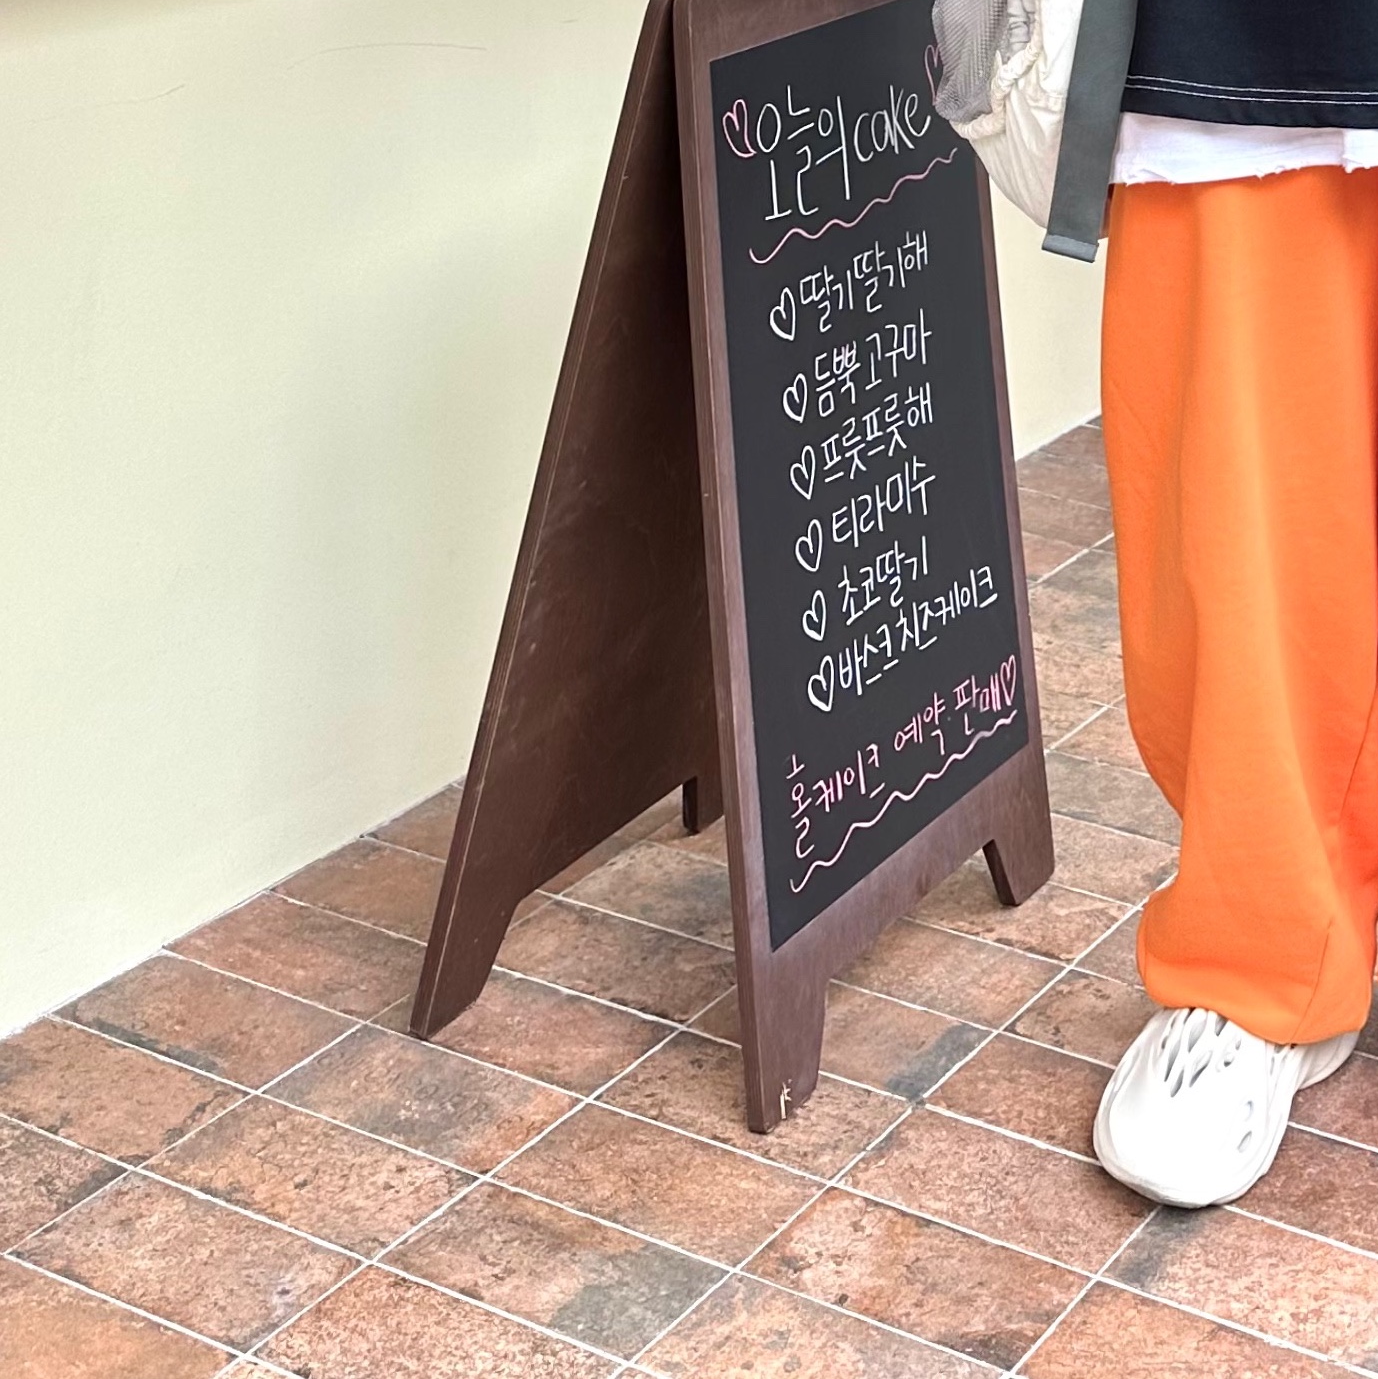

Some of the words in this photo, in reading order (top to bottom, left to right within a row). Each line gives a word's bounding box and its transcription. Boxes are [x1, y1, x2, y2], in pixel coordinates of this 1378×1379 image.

[832, 455, 936, 548] 티라미수
[838, 535, 928, 626] 초코딸기
[894, 692, 946, 755] 예약
[953, 673, 1001, 736] 판매
